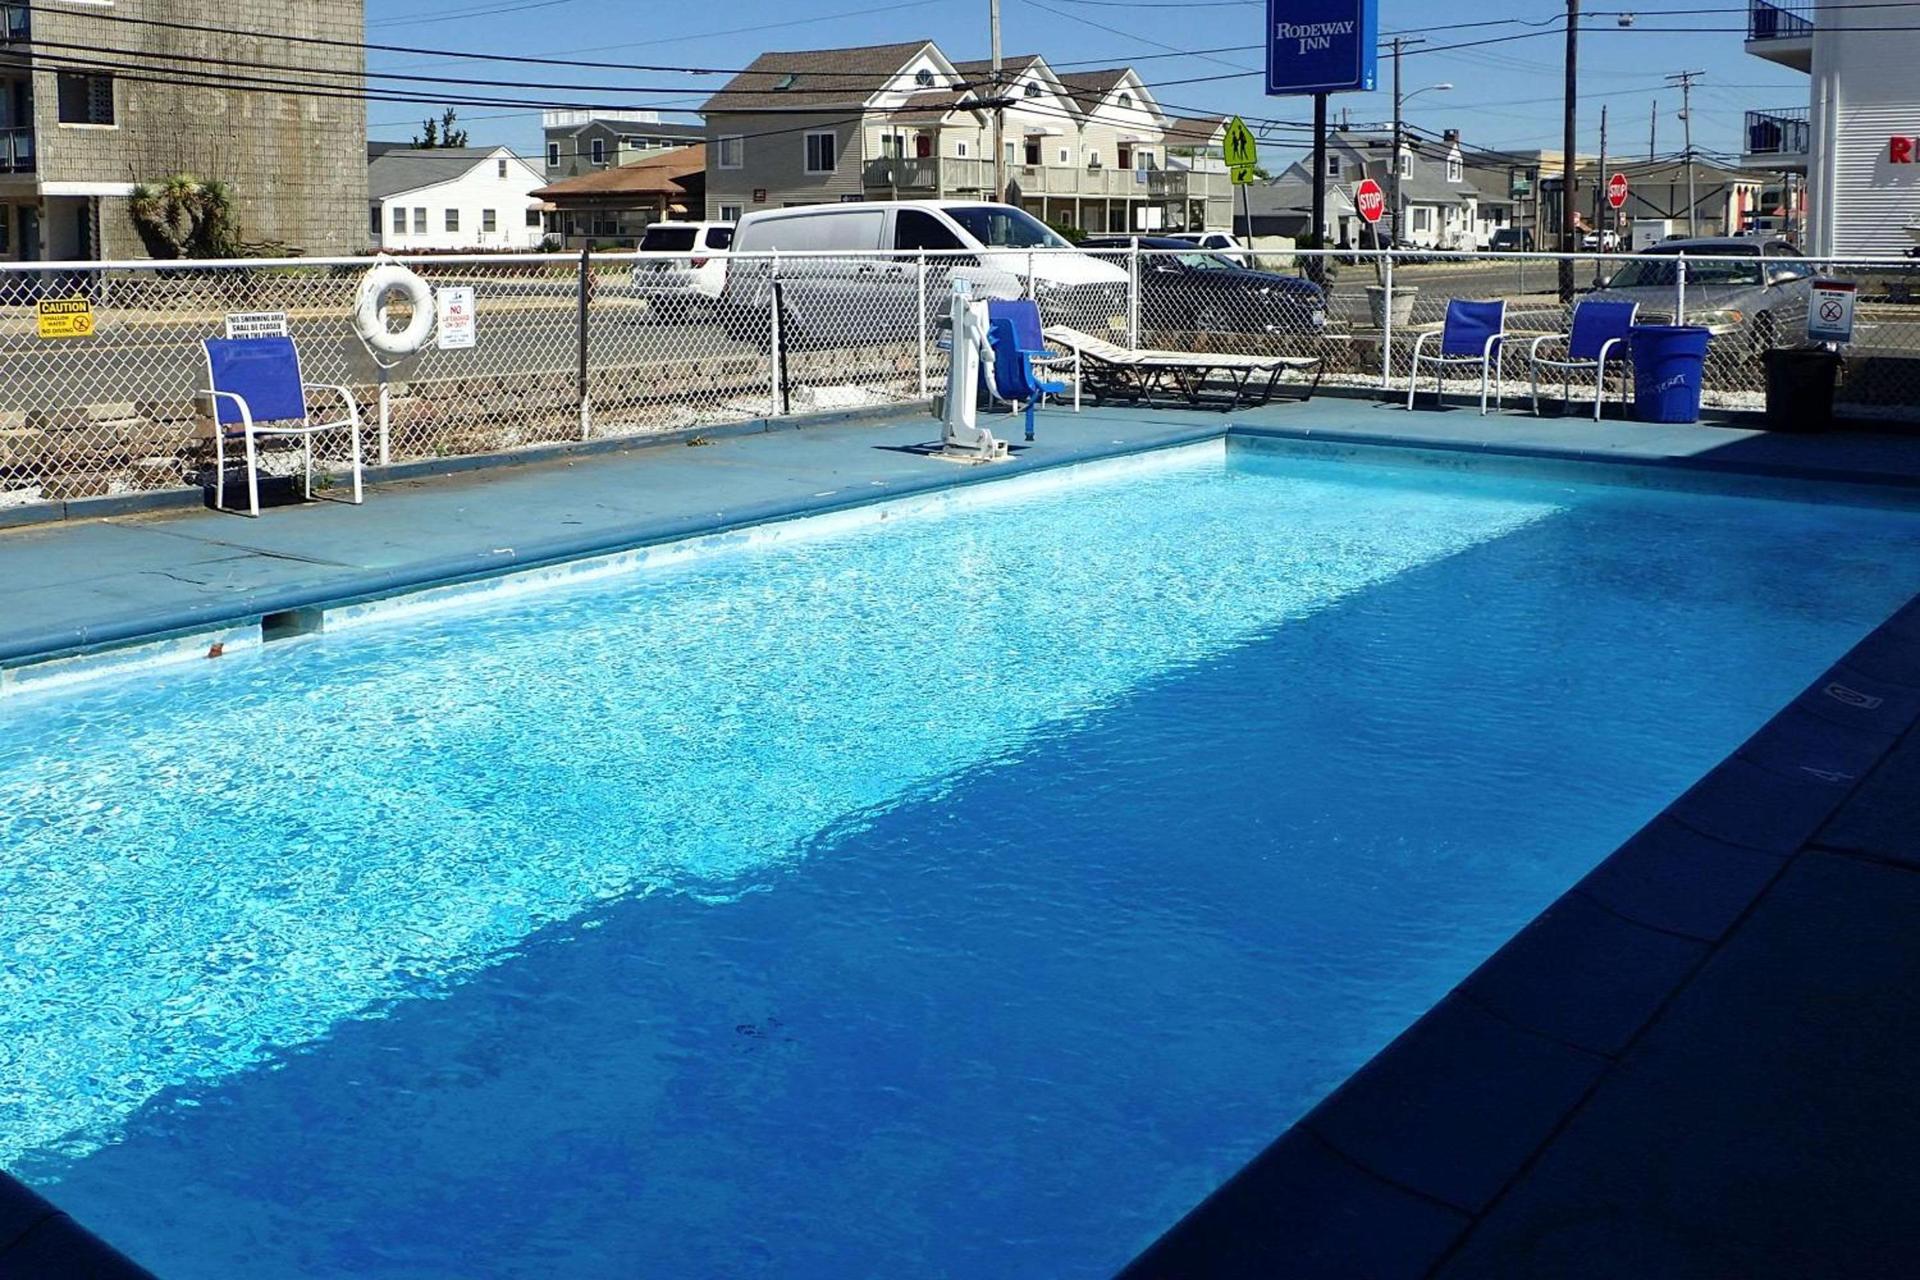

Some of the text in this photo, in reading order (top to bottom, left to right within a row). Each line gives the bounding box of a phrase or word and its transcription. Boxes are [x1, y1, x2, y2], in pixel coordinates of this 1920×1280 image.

[1298, 36, 1330, 54] INN
[1610, 184, 1625, 197] STOP
[1360, 192, 1380, 210] STOP
[41, 302, 87, 312] CAUTION
[450, 304, 461, 314] NO
